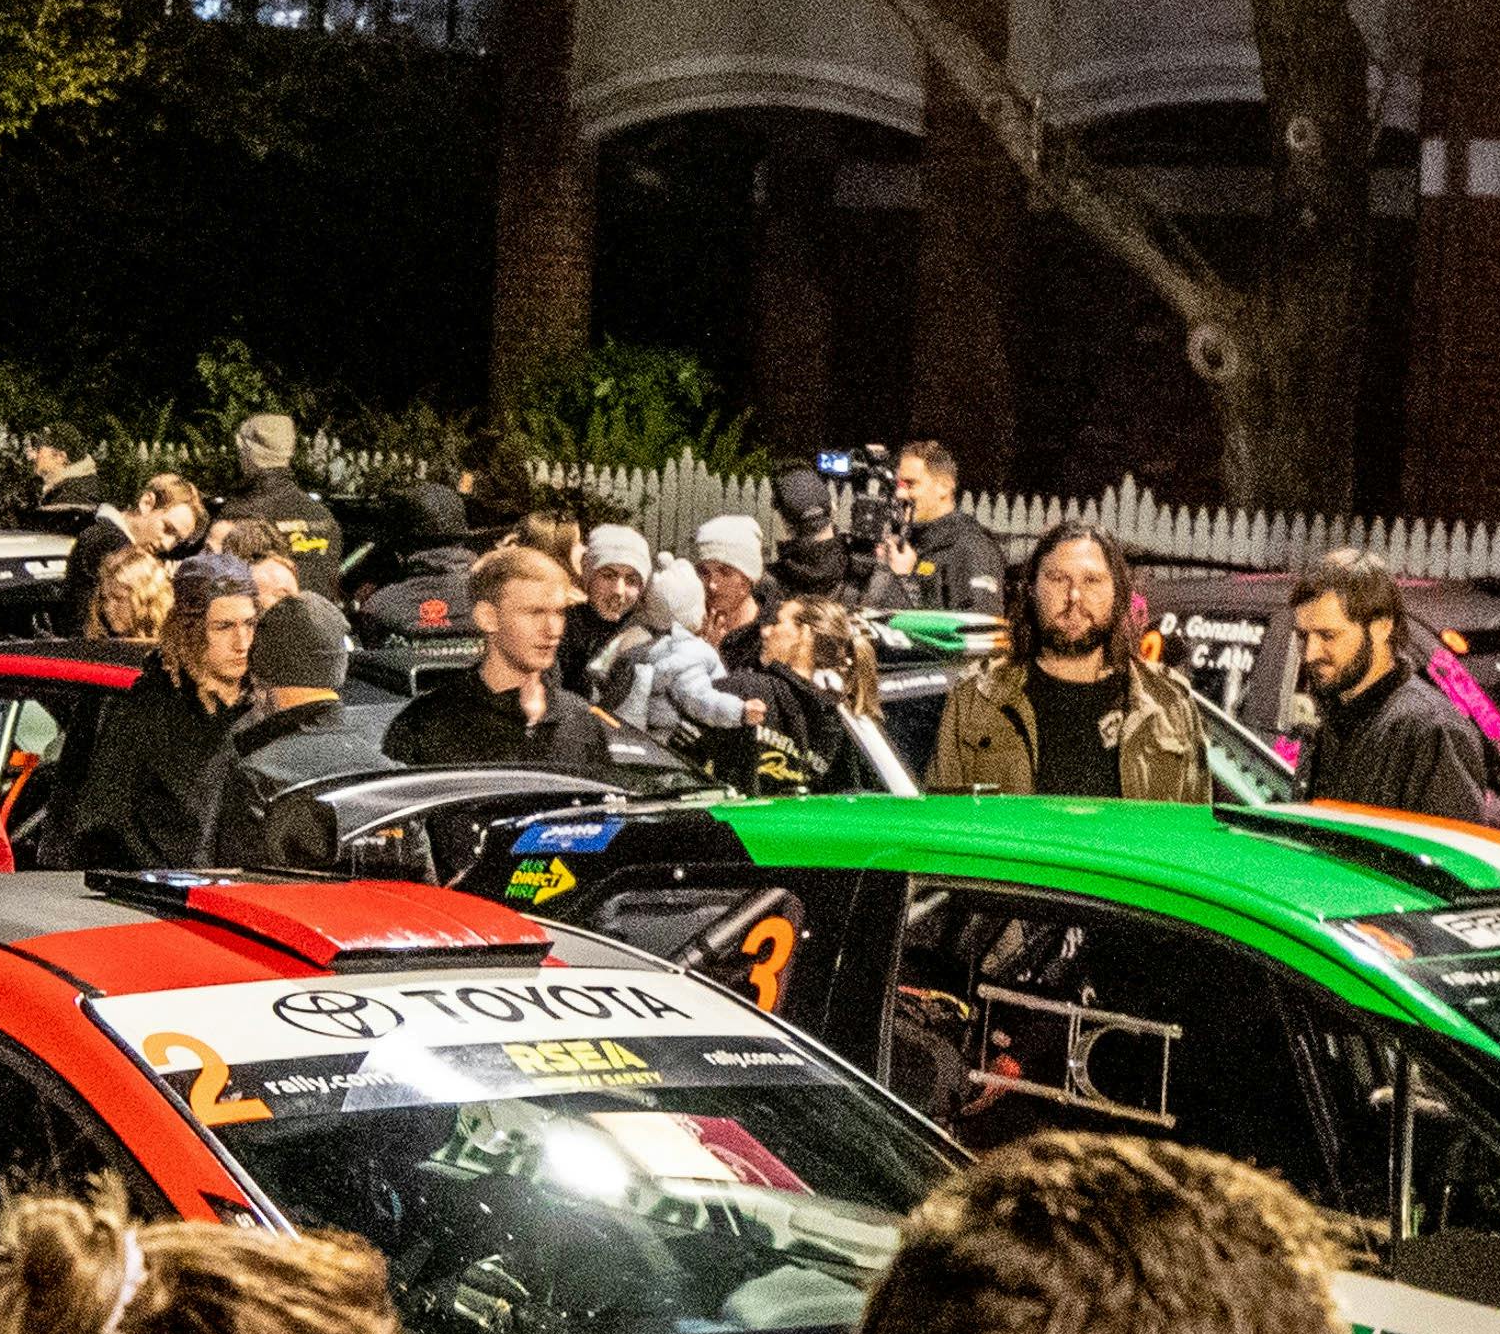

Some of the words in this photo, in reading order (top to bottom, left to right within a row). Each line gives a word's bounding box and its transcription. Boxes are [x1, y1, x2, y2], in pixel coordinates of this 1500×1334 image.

[511, 869, 562, 889] DIRECT
[742, 915, 794, 1013] 3
[400, 983, 693, 1024] TOYOTA
[502, 1040, 649, 1073] RSEA
[142, 1031, 274, 1127] 2
